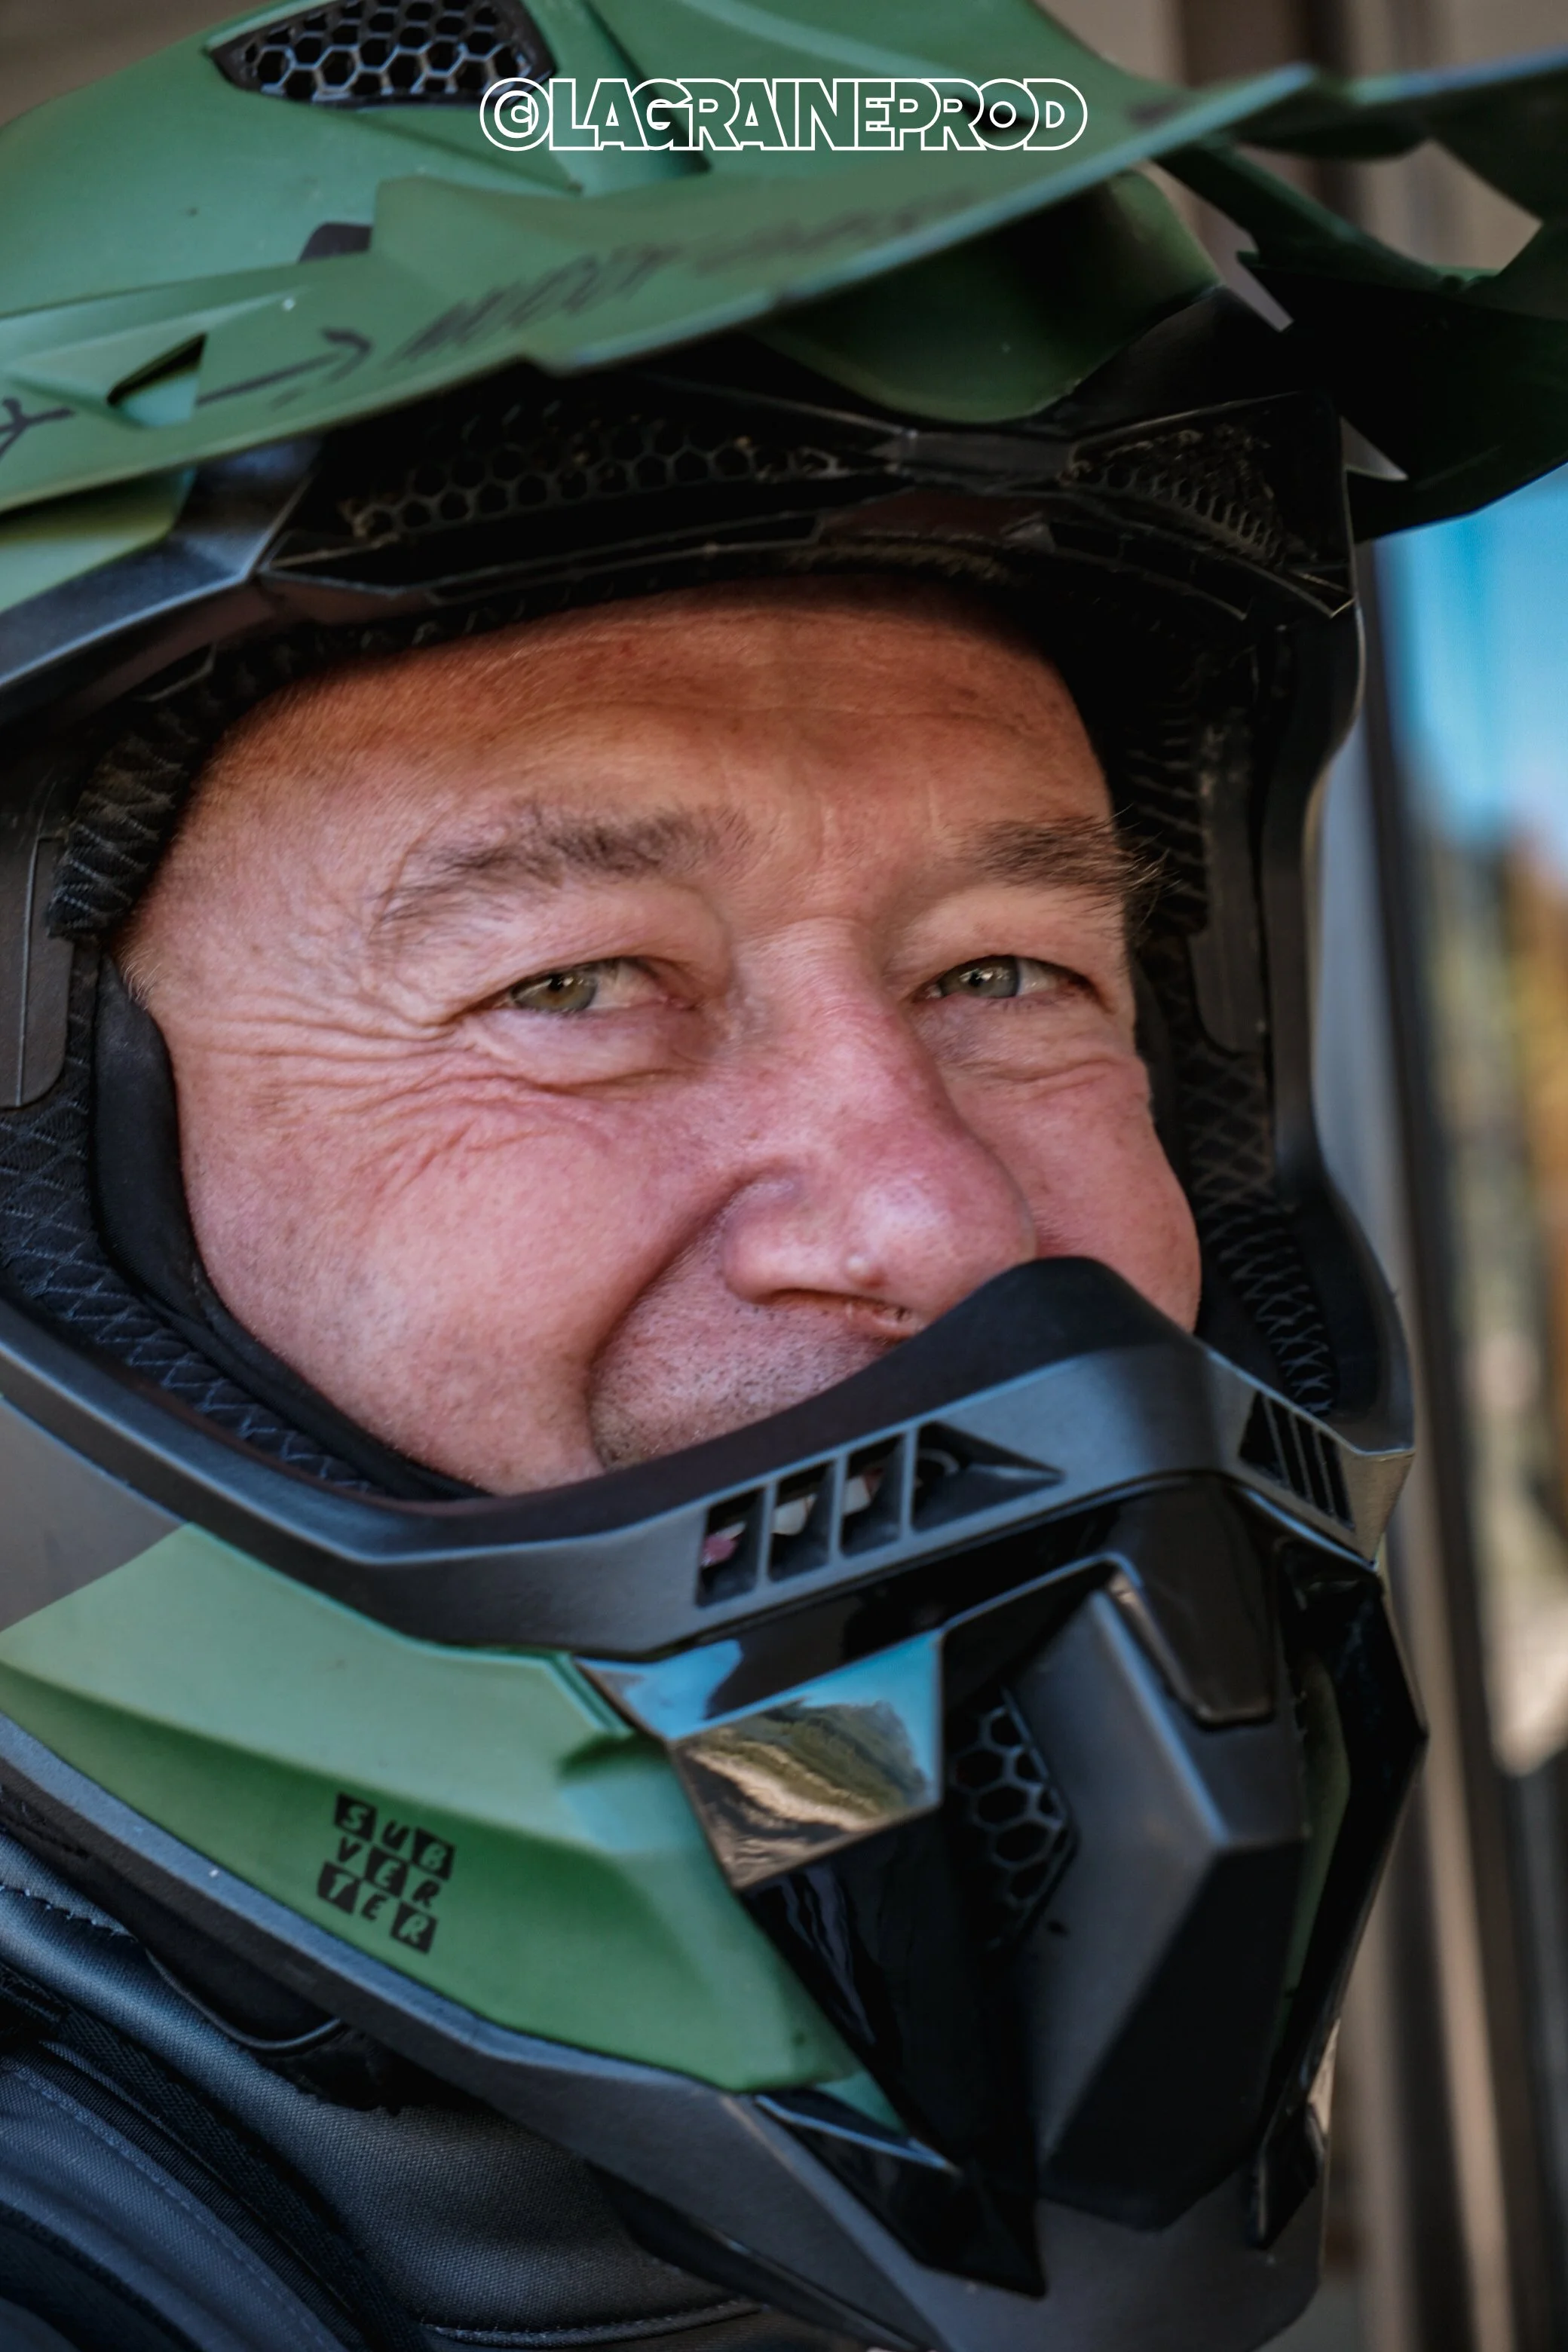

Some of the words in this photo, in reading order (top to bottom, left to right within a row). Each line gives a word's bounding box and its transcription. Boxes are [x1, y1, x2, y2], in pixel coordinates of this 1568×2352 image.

[337, 1836, 442, 1908] VER
[338, 1798, 452, 1876] SUB
[323, 1868, 433, 1948] TER
